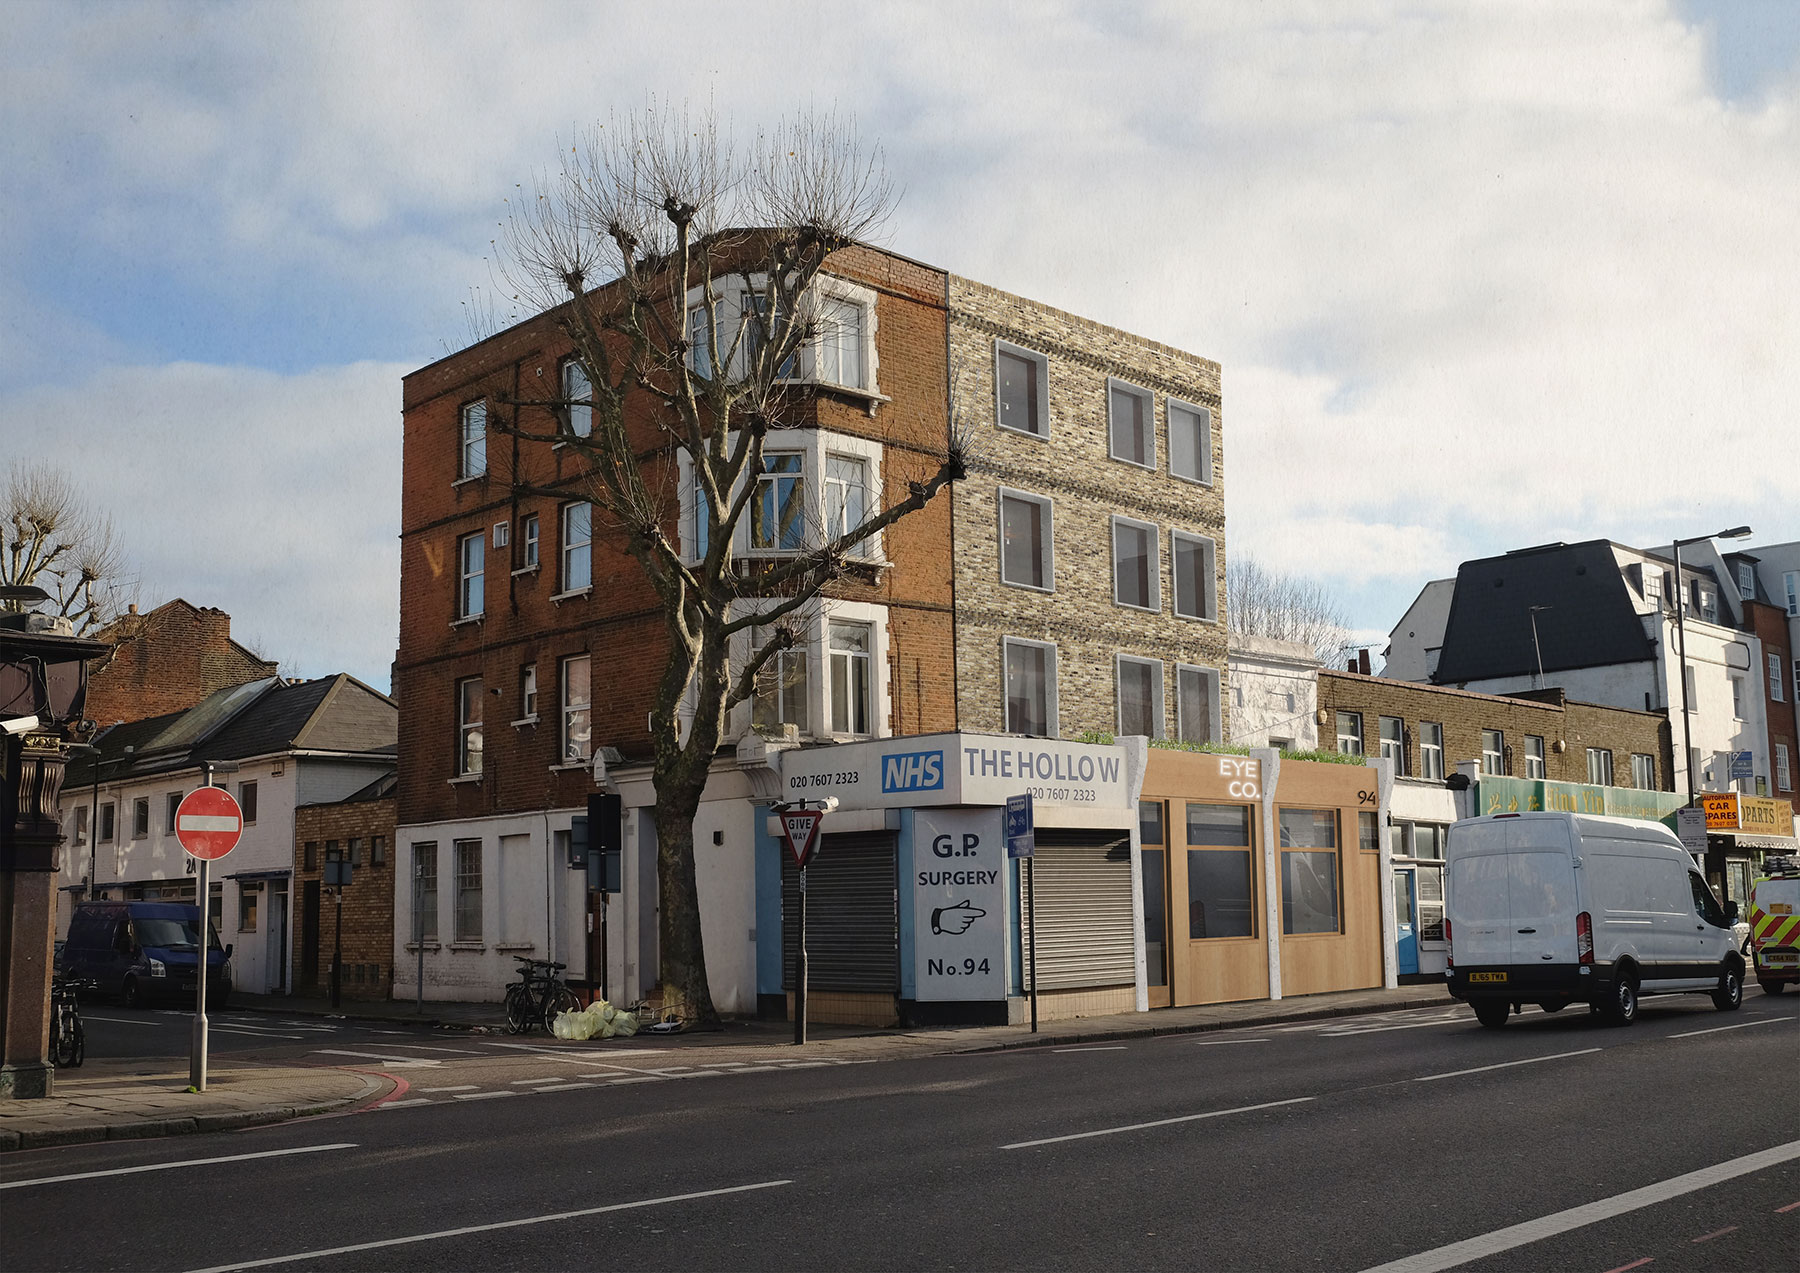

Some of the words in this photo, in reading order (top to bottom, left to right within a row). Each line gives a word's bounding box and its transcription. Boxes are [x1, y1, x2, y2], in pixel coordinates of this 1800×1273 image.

[885, 754, 941, 790] NHS
[964, 748, 1012, 778] THE
[1018, 751, 1120, 783] HOLLOW
[1219, 758, 1258, 778] EYE
[790, 775, 807, 788] 020
[810, 773, 832, 787] 7607
[835, 771, 859, 785] 2323
[1047, 787, 1070, 801] 7607
[1073, 789, 1096, 802] 2323
[1229, 781, 1261, 799] CO.
[1357, 790, 1376, 806] 94
[1582, 789, 1604, 815] Yip
[1709, 802, 1730, 811] CAR
[788, 819, 812, 830] GIVE
[792, 832, 807, 840] WAY
[932, 833, 980, 858] G.P.
[186, 858, 197, 874] 2A
[918, 870, 998, 886] SURGERY
